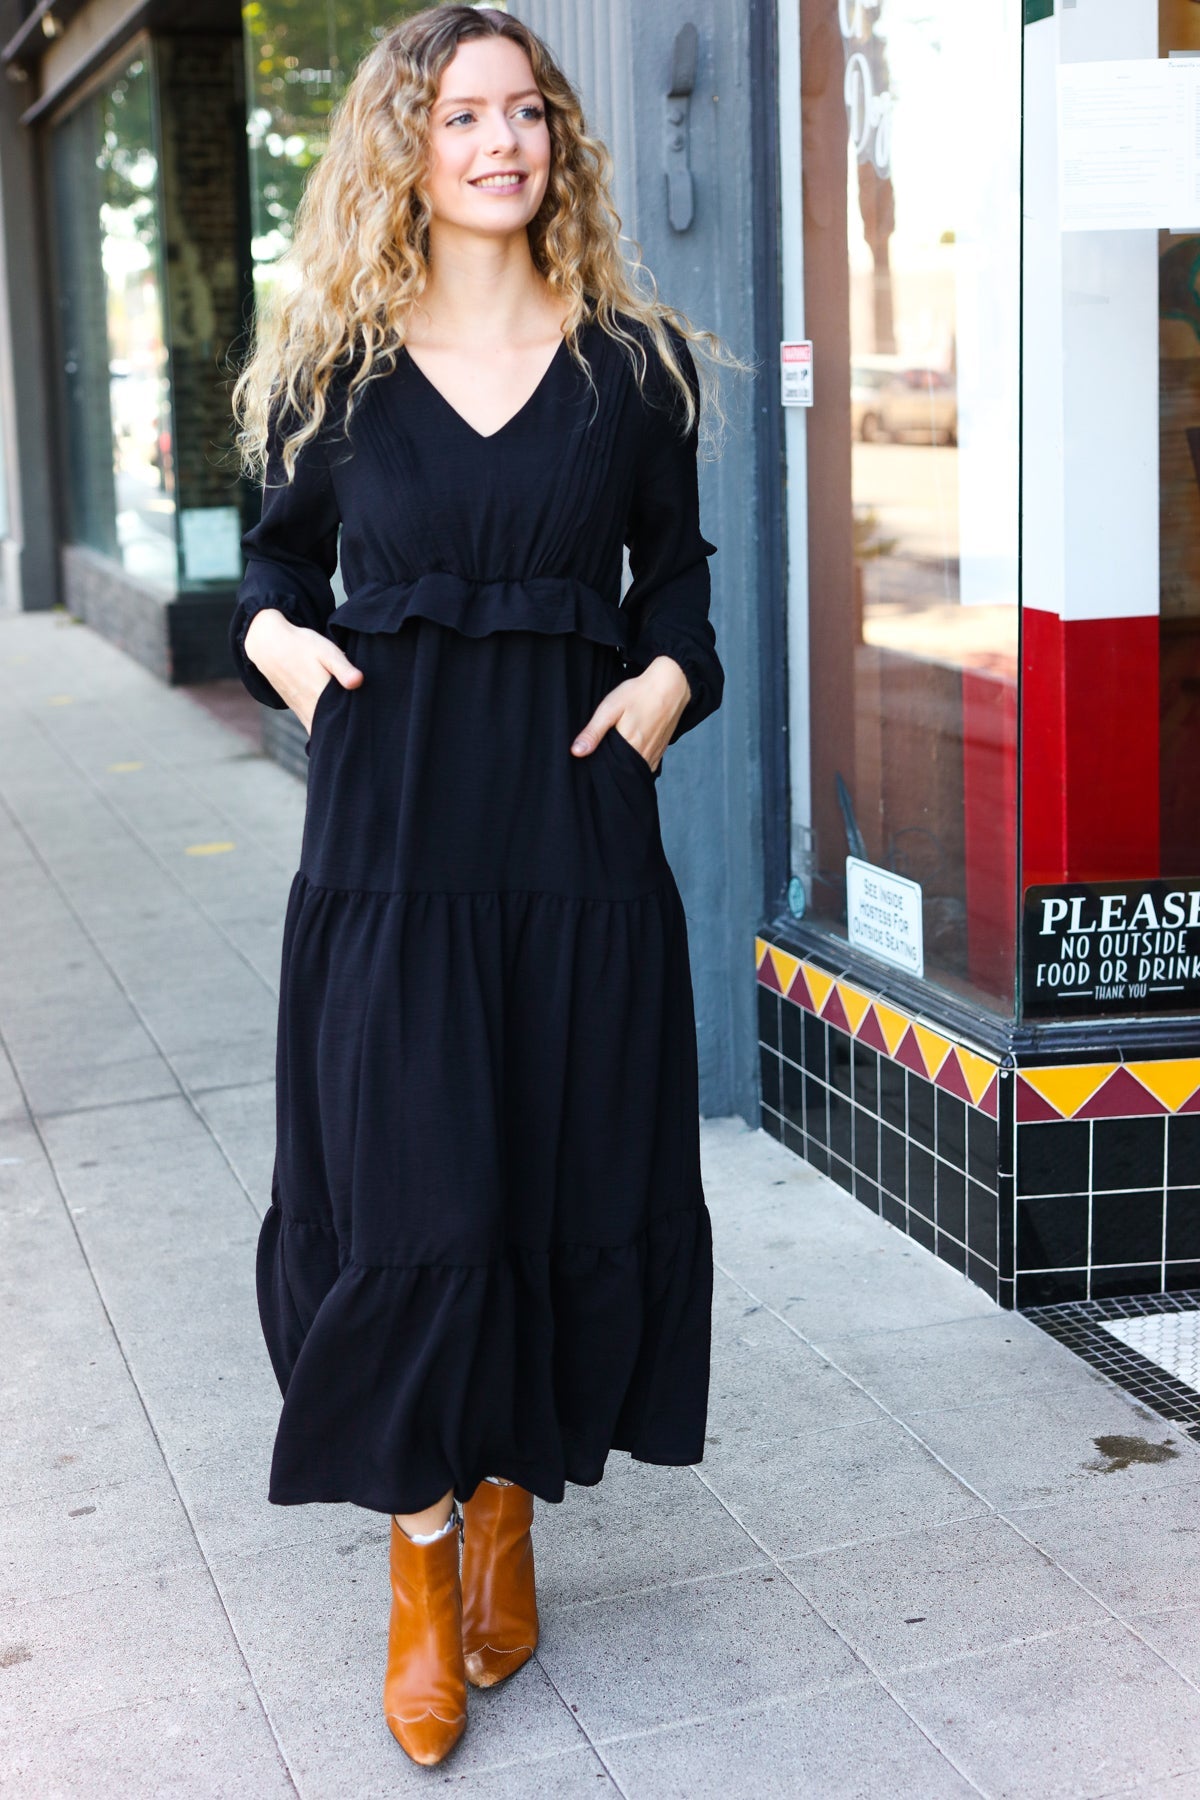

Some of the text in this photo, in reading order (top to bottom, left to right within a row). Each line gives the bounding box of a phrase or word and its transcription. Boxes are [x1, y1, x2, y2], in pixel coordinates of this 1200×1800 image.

[863, 877, 904, 911] SEE INSIDE
[860, 901, 910, 935] HOSTESS FOR
[854, 916, 918, 962] OUTSIDE SEATING
[1061, 930, 1188, 960] NO OUTSIDE
[1036, 962, 1091, 987] FOOD
[1100, 959, 1128, 984] OR
[1095, 983, 1147, 1001] THANK YOU
